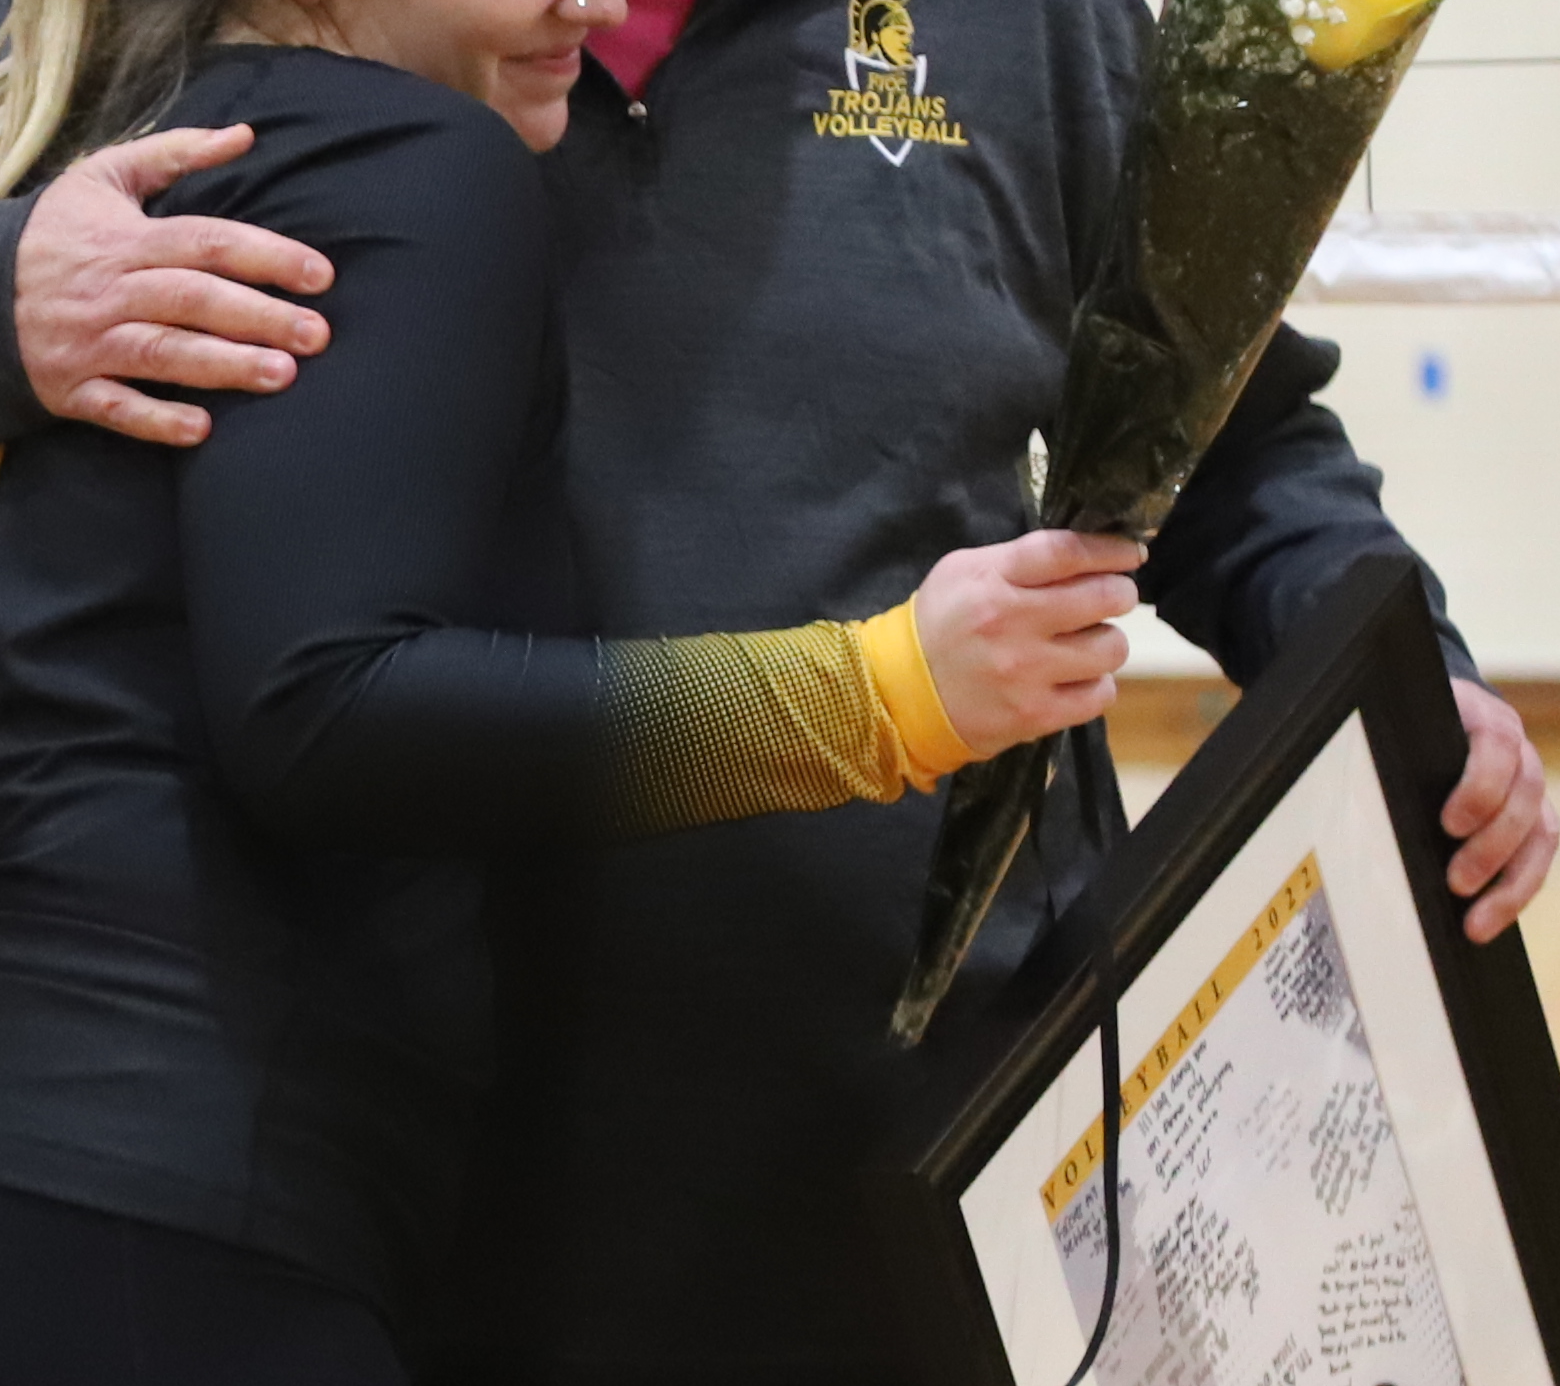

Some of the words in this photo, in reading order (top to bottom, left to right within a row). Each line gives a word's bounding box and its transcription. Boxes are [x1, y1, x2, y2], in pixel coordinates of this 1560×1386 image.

[828, 89, 946, 120] TROJANS
[813, 112, 969, 146] VOLLEYBALL
[1042, 980, 1225, 1208] VOLEYBALL
[1252, 865, 1313, 951] 2022
